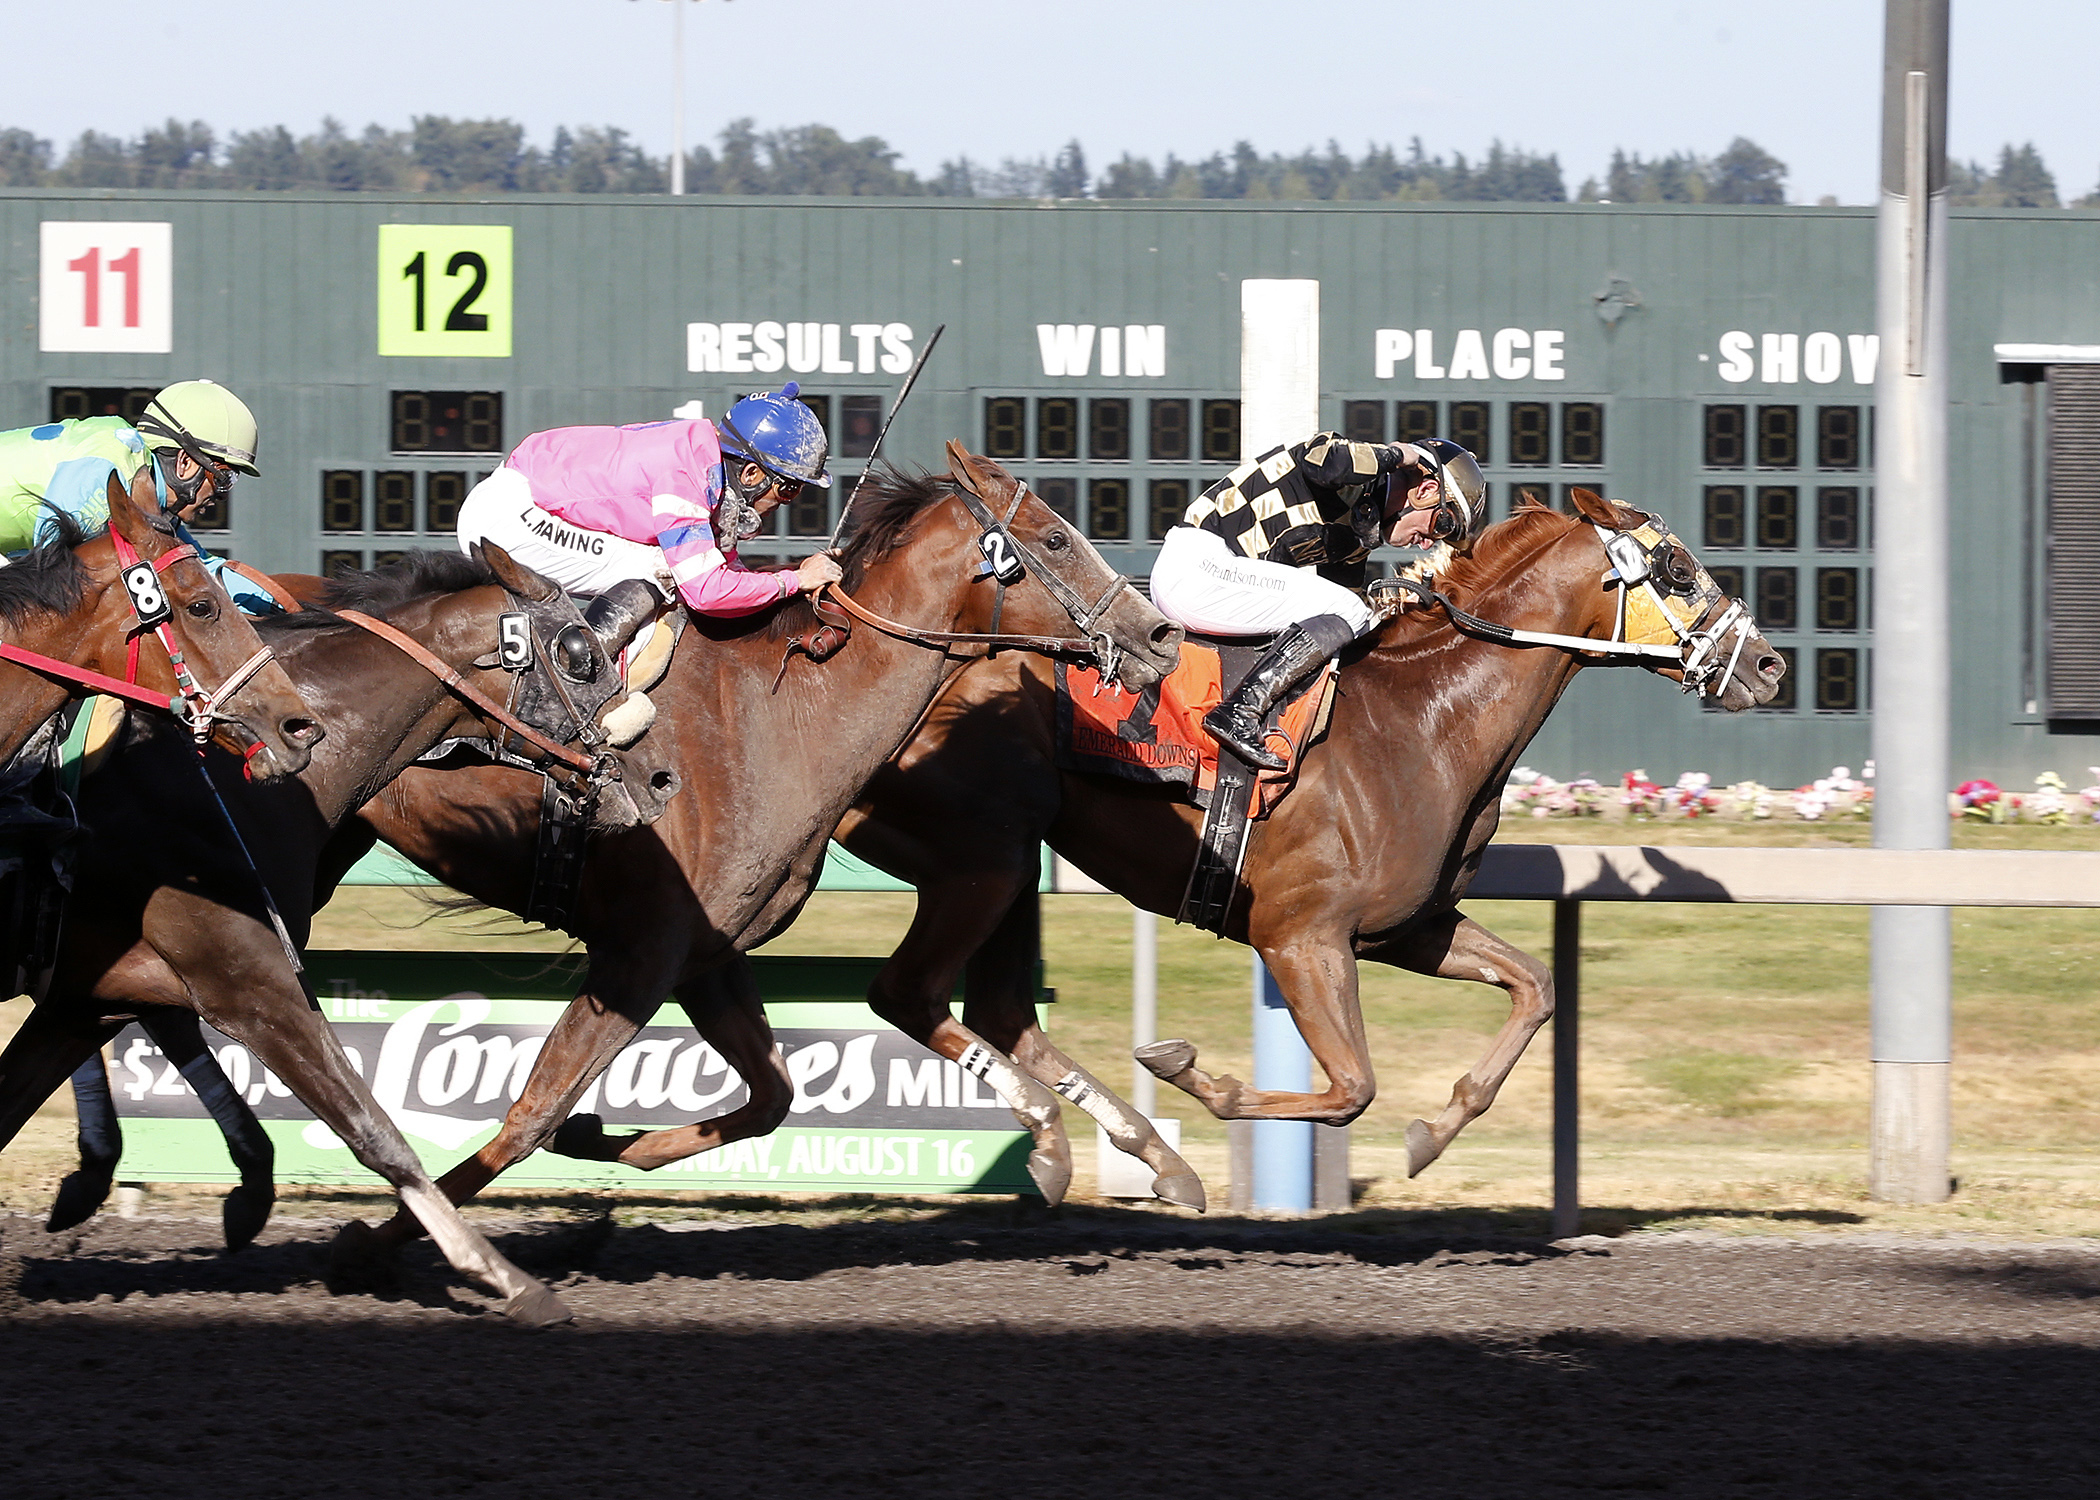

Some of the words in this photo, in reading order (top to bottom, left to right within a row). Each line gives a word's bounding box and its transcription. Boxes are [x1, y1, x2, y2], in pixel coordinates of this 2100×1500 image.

[68, 246, 141, 328] 11
[403, 251, 489, 332] 12
[686, 322, 914, 374] RESULTS
[1036, 323, 1166, 377] WIN
[1374, 327, 1566, 380] PLACE
[983, 531, 1017, 575] 2
[127, 567, 162, 614] 8
[502, 616, 528, 662] 5
[1078, 726, 1143, 763] EMERALD
[1146, 742, 1197, 769] DOWNS
[326, 978, 390, 1019] The
[302, 991, 878, 1150] Lonaces
[886, 1058, 1013, 1109] MIL
[786, 1135, 925, 1177] AUGUST
[931, 1139, 975, 1178] 16
